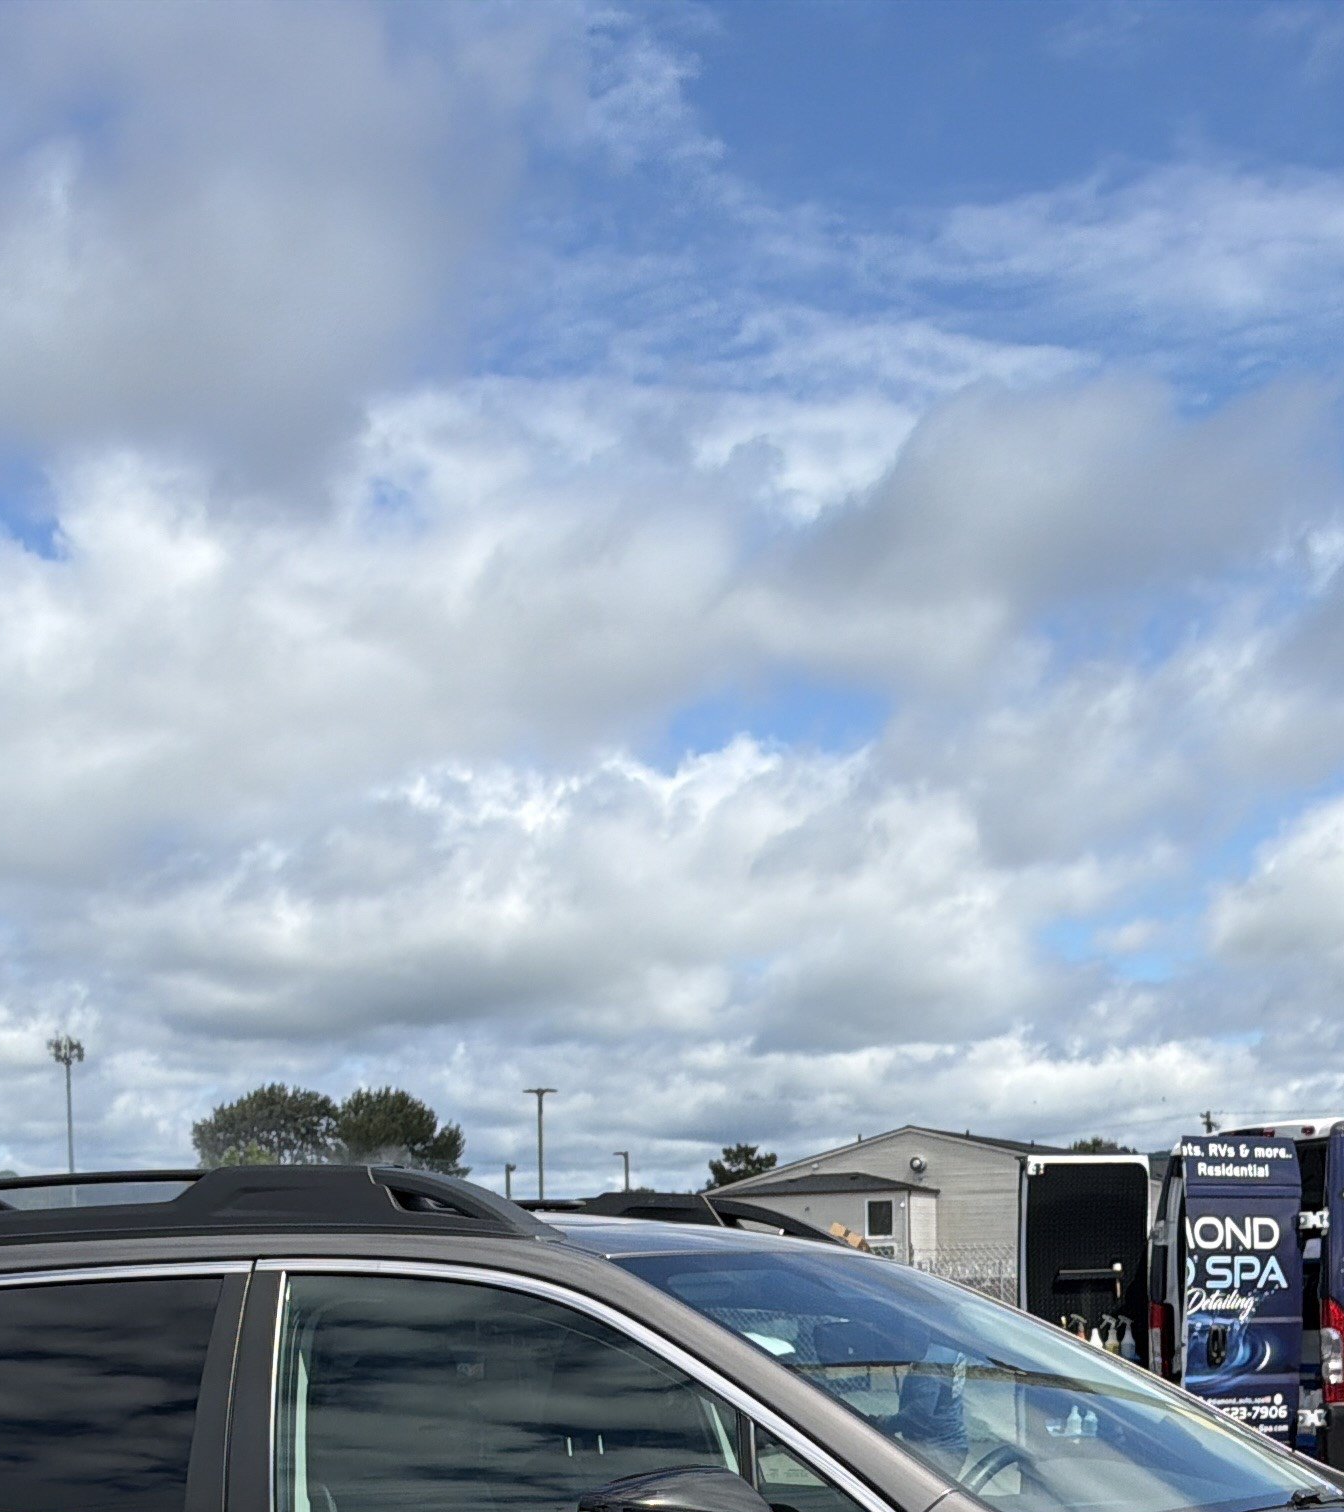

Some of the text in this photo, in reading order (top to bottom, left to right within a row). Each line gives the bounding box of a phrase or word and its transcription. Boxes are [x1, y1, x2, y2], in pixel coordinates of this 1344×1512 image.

[1208, 1143, 1235, 1158] RVs
[1239, 1143, 1250, 1158] &
[1197, 1162, 1269, 1177] Residential
[1206, 1255, 1288, 1288] SPA
[1187, 1287, 1255, 1323] Detailing
